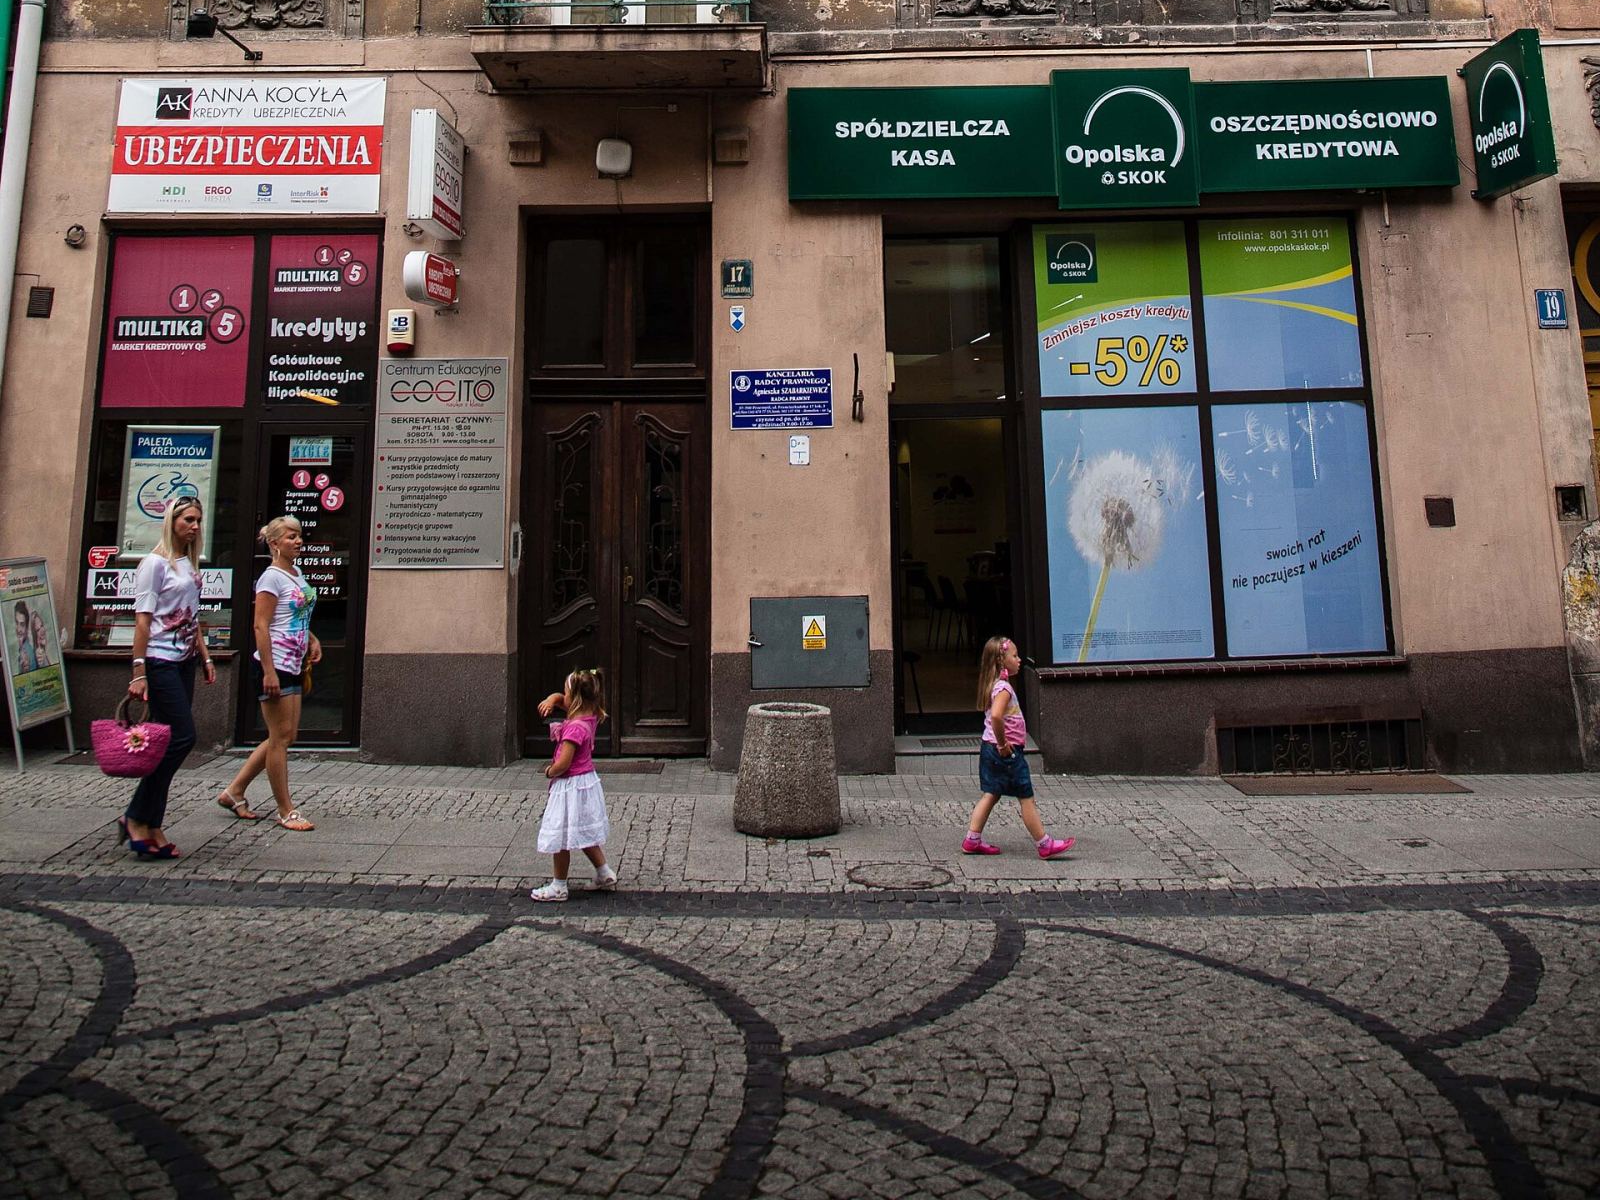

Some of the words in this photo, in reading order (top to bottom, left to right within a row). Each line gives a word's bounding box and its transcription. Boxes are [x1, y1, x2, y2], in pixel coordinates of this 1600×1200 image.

[195, 88, 258, 102] ANNA
[266, 86, 348, 102] KOCYŁA
[193, 108, 244, 118] KREDYTY
[254, 107, 346, 118] UBEZPIECZENIA
[835, 118, 1010, 138] SPÓŁDZIELCZA
[1210, 109, 1437, 134] OSZCZĘDNOŚCIOWO
[1476, 120, 1518, 154] Opolska
[124, 134, 372, 166] UBEZPIECZENIA
[891, 150, 956, 166] KASA
[1065, 144, 1165, 168] Opolska
[1256, 140, 1400, 160] KREDYTOWA
[1498, 144, 1520, 167] SKOK
[1118, 170, 1166, 184] SKOK
[162, 186, 186, 196] HDI
[204, 186, 232, 196] ERGO
[1217, 230, 1264, 241] infolinia:
[1270, 230, 1287, 240] 801
[1291, 229, 1308, 239] 311
[1312, 228, 1329, 239] 011
[1244, 242, 1330, 254] www.opolskaskok.pl
[321, 249, 328, 262] 1
[340, 251, 350, 262] 2
[349, 266, 362, 282] 5
[1050, 262, 1086, 271] Opolska
[730, 266, 744, 282] 17
[178, 290, 189, 308] 1
[205, 293, 220, 308] 2
[217, 312, 235, 336] 5
[1544, 296, 1560, 318] 19
[270, 318, 366, 342] kredyty:
[1042, 317, 1097, 351] Zmniejsz
[1100, 306, 1142, 326] koszty
[1145, 304, 1190, 320] kredytu
[194, 342, 206, 351] QS
[270, 354, 342, 366] Gotówkowe
[269, 370, 364, 384] Konsolidacyjne
[386, 364, 434, 376] Centrum
[438, 364, 502, 376] Edukacyjne
[268, 387, 338, 400] Hipoteczne
[390, 380, 494, 402] COGITO
[753, 388, 780, 396] Agnieszka
[138, 437, 172, 446] PALETA
[150, 444, 207, 456] KREDYTÓW
[298, 472, 306, 486] 1
[317, 475, 328, 486] 2
[326, 490, 340, 506] 5
[308, 545, 330, 553] Kocyła
[442, 546, 480, 554] egzaminów
[1266, 540, 1304, 560] swoich
[1308, 528, 1326, 550] rat
[1232, 576, 1248, 588] nie
[1252, 562, 1306, 590] poczujesz
[1309, 558, 1318, 572] w
[1321, 530, 1362, 566] kieszeni
[311, 574, 334, 582] Kocyła
